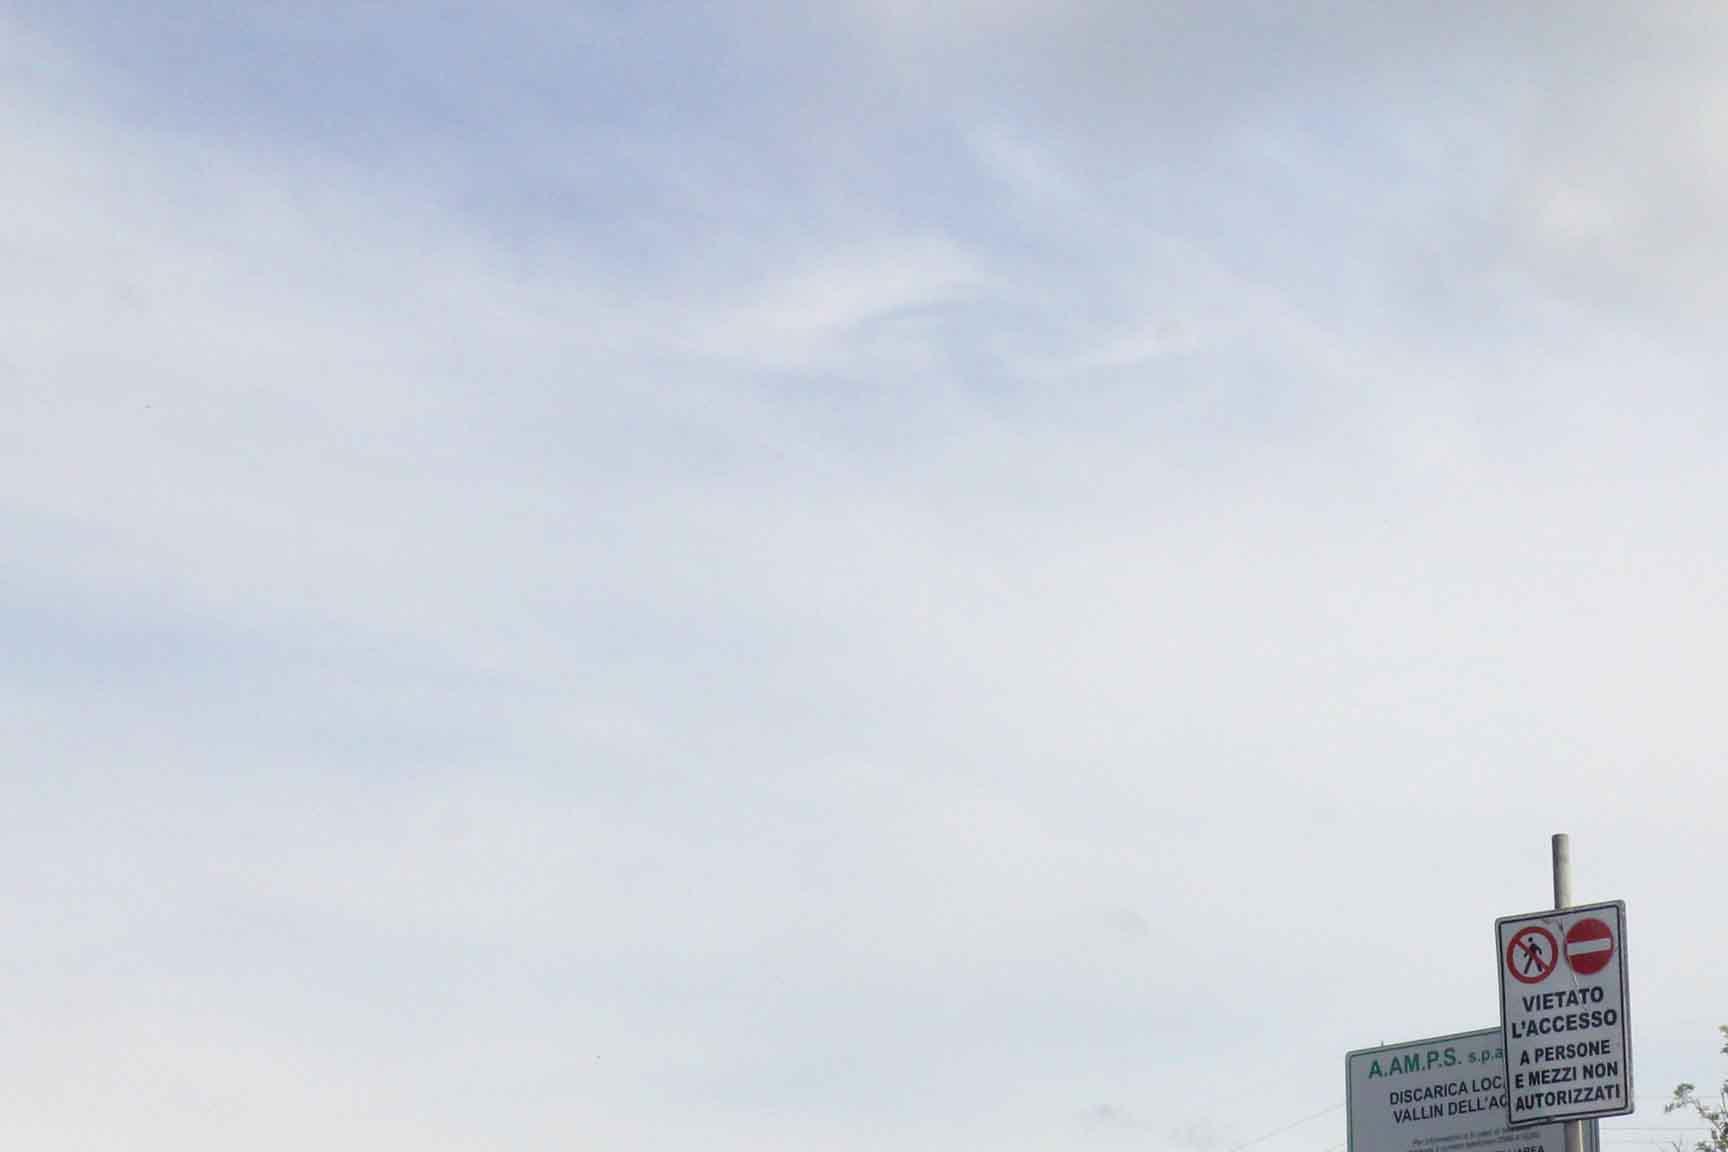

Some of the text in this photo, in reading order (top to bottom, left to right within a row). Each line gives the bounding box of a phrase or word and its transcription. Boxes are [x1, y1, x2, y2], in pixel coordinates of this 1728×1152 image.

[1522, 986, 1604, 1012] VIETATO
[1511, 1009, 1617, 1039] L'ACCESSO
[1520, 1039, 1610, 1066] A PERSONE
[1515, 1061, 1618, 1089] E MEZZI NON
[1389, 1075, 1506, 1105] DISCARICA LOC
[1515, 1084, 1620, 1113] AUTORIZZATI
[1393, 1105, 1444, 1124] VALLIN
